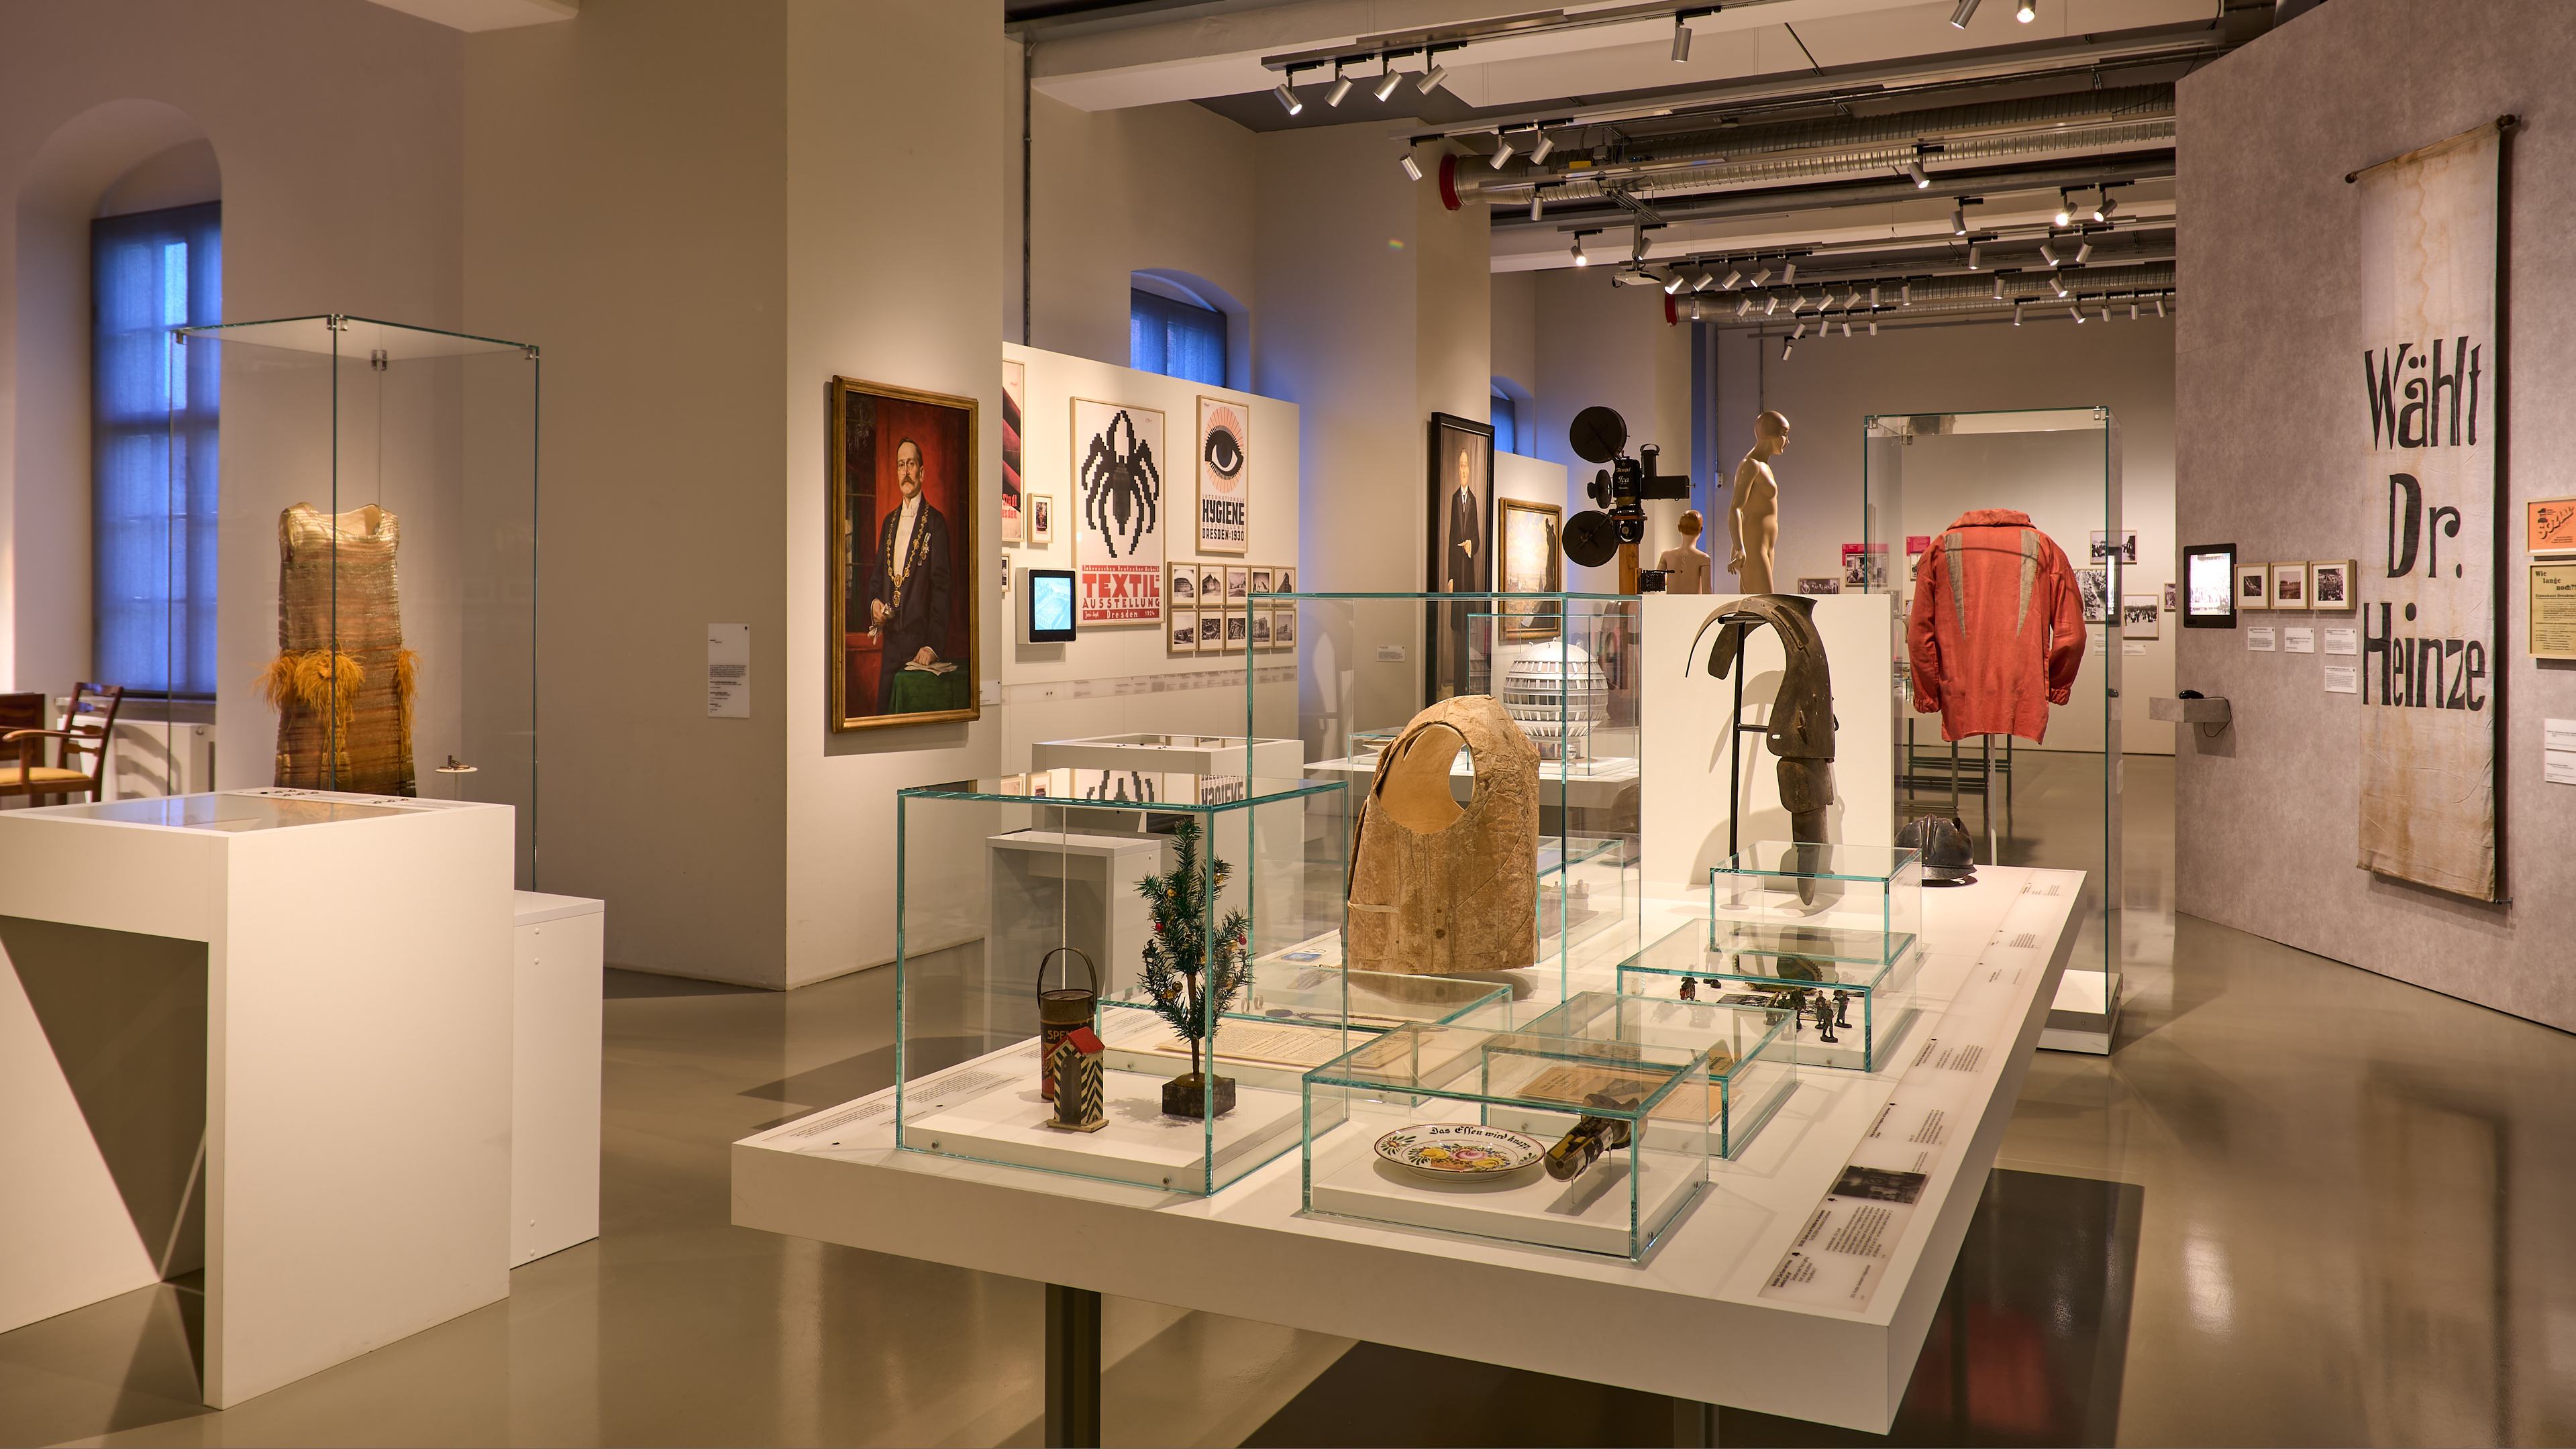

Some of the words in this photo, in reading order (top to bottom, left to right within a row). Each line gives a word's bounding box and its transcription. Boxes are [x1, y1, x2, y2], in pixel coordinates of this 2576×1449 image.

[2364, 335, 2481, 451] Wählt
[1002, 493, 1017, 506] Stadt
[1202, 499, 1245, 525] HYGIENE
[2387, 473, 2462, 579] Dr.
[1202, 528, 1229, 540] DRESDEN
[1231, 530, 1244, 541] 1930
[1082, 598, 1160, 609] AUSSTELLUNG
[1106, 609, 1138, 619] Dresden
[2363, 602, 2485, 711] Heinze
[1047, 1030, 1070, 1040] SPE
[1485, 1131, 1508, 1140] wird
